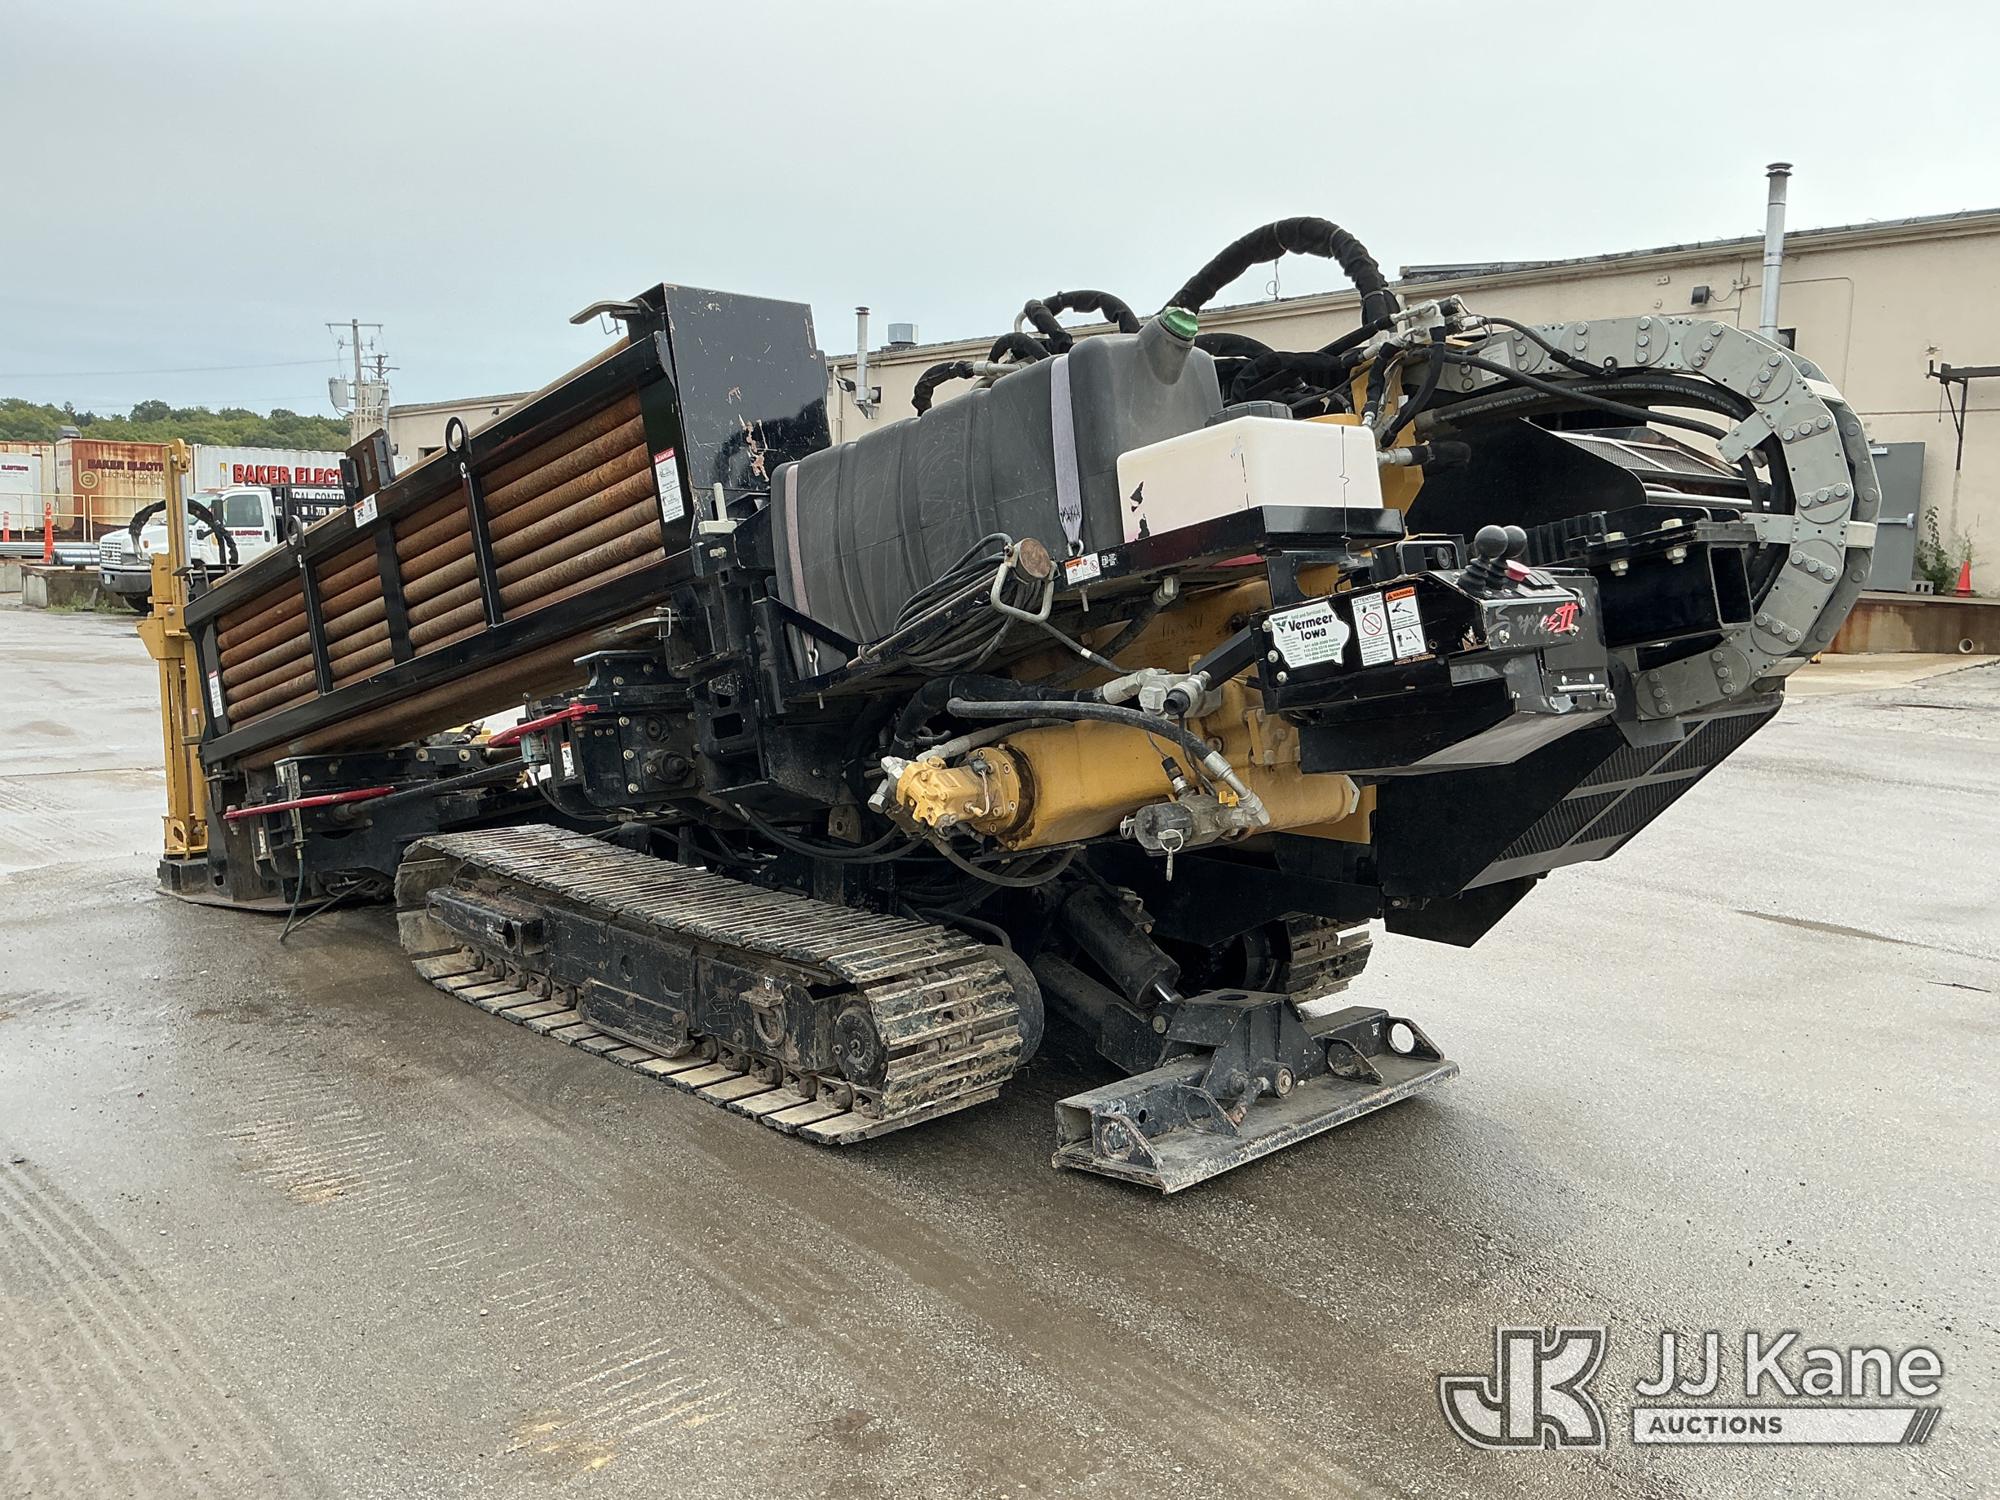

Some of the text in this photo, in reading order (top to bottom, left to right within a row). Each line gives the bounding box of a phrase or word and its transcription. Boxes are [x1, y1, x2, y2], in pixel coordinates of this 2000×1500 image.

[88, 459, 124, 470] BAKER
[233, 464, 291, 484] BAKER
[1353, 594, 1380, 604] ATTENTION
[1288, 614, 1333, 632] Vermeer
[1301, 627, 1327, 641] Iowa
